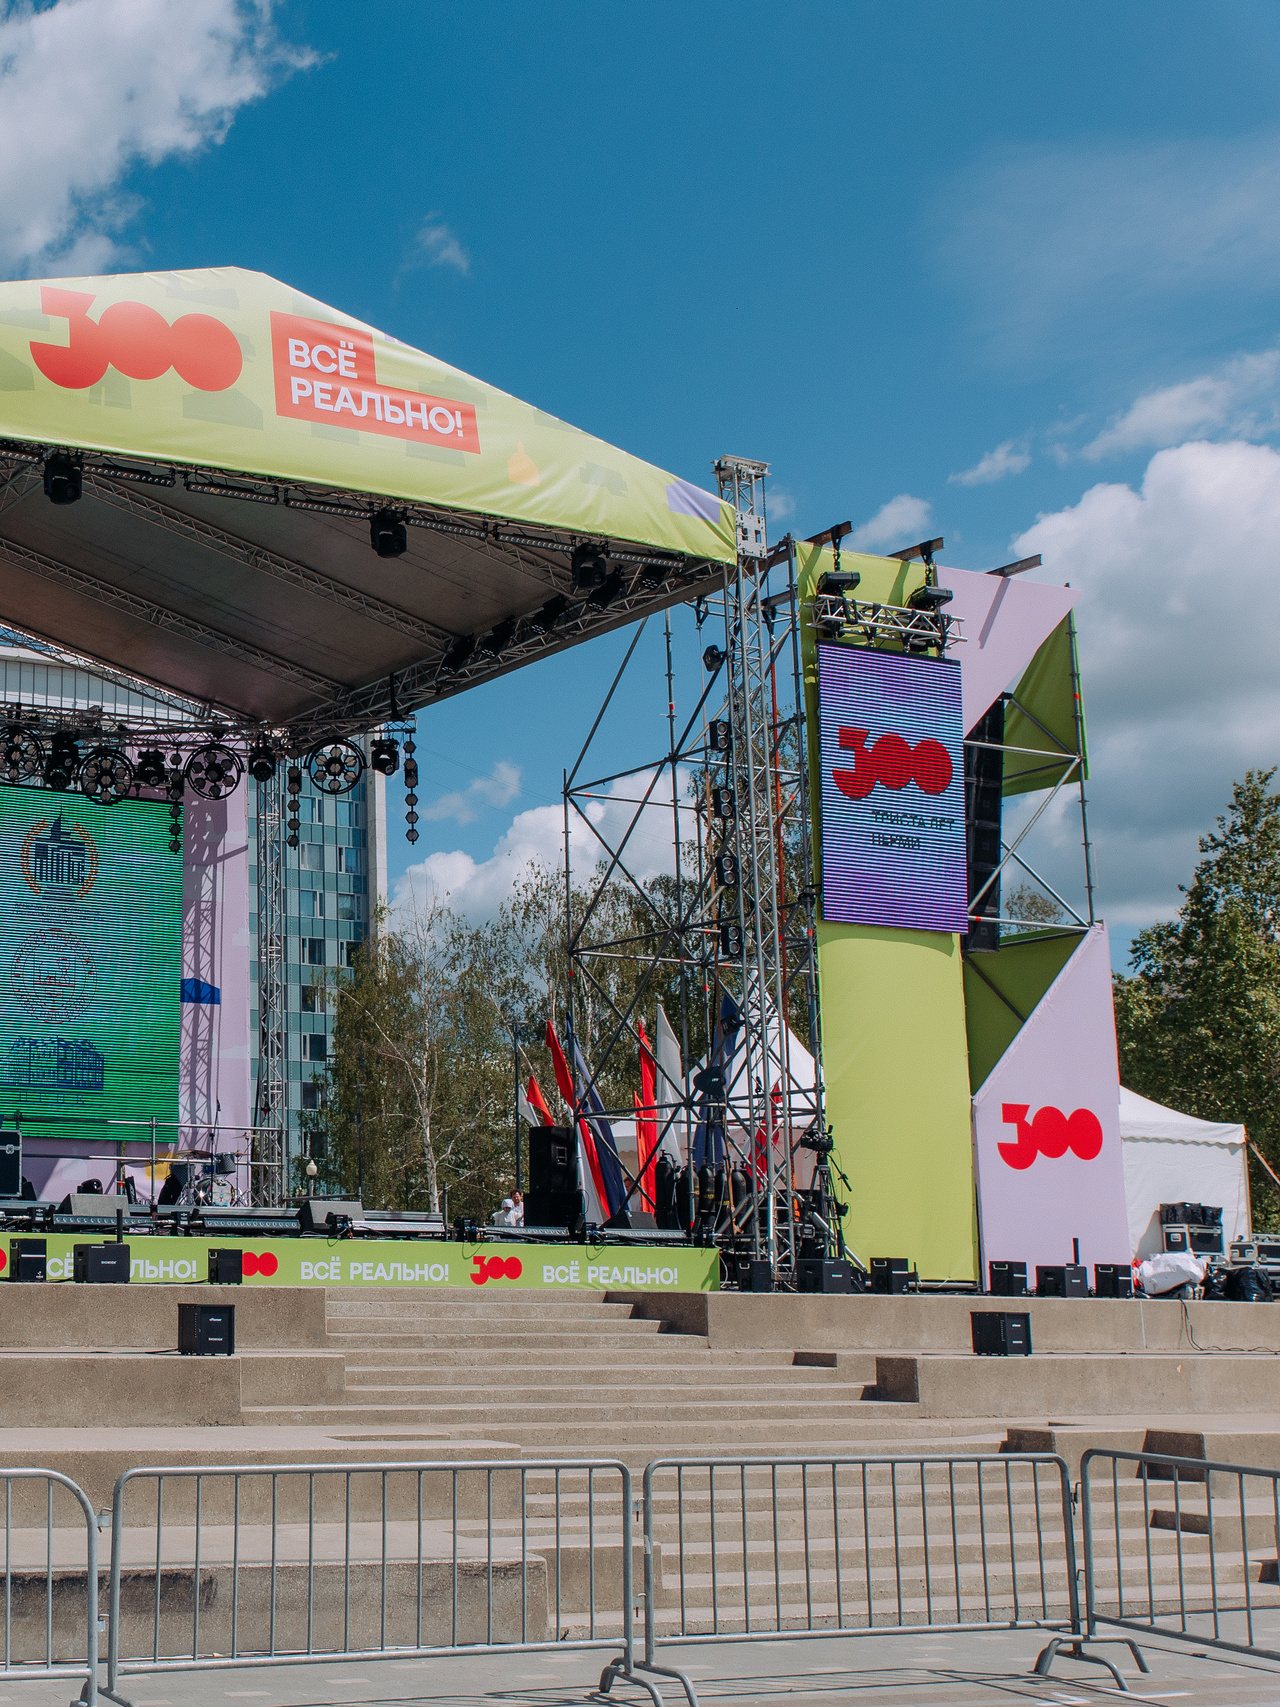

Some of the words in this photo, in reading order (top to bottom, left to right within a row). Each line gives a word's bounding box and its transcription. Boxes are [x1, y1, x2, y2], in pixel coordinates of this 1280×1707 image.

[29, 285, 243, 390] 300
[288, 338, 358, 379] ВСЁ
[291, 376, 464, 437] РЕАЛЬНО!
[832, 726, 953, 800] 300
[997, 1103, 1103, 1170] 300
[45, 1252, 74, 1278] СЁ
[129, 1259, 196, 1279] ЛЬНО!
[242, 1252, 278, 1277] 00
[300, 1256, 341, 1281] ВСЁ
[349, 1262, 449, 1282] РЕАЛЬНО!
[470, 1256, 522, 1285] 300
[543, 1260, 580, 1284] ВСЁ
[587, 1265, 678, 1285] РЕАЛЬНО!
